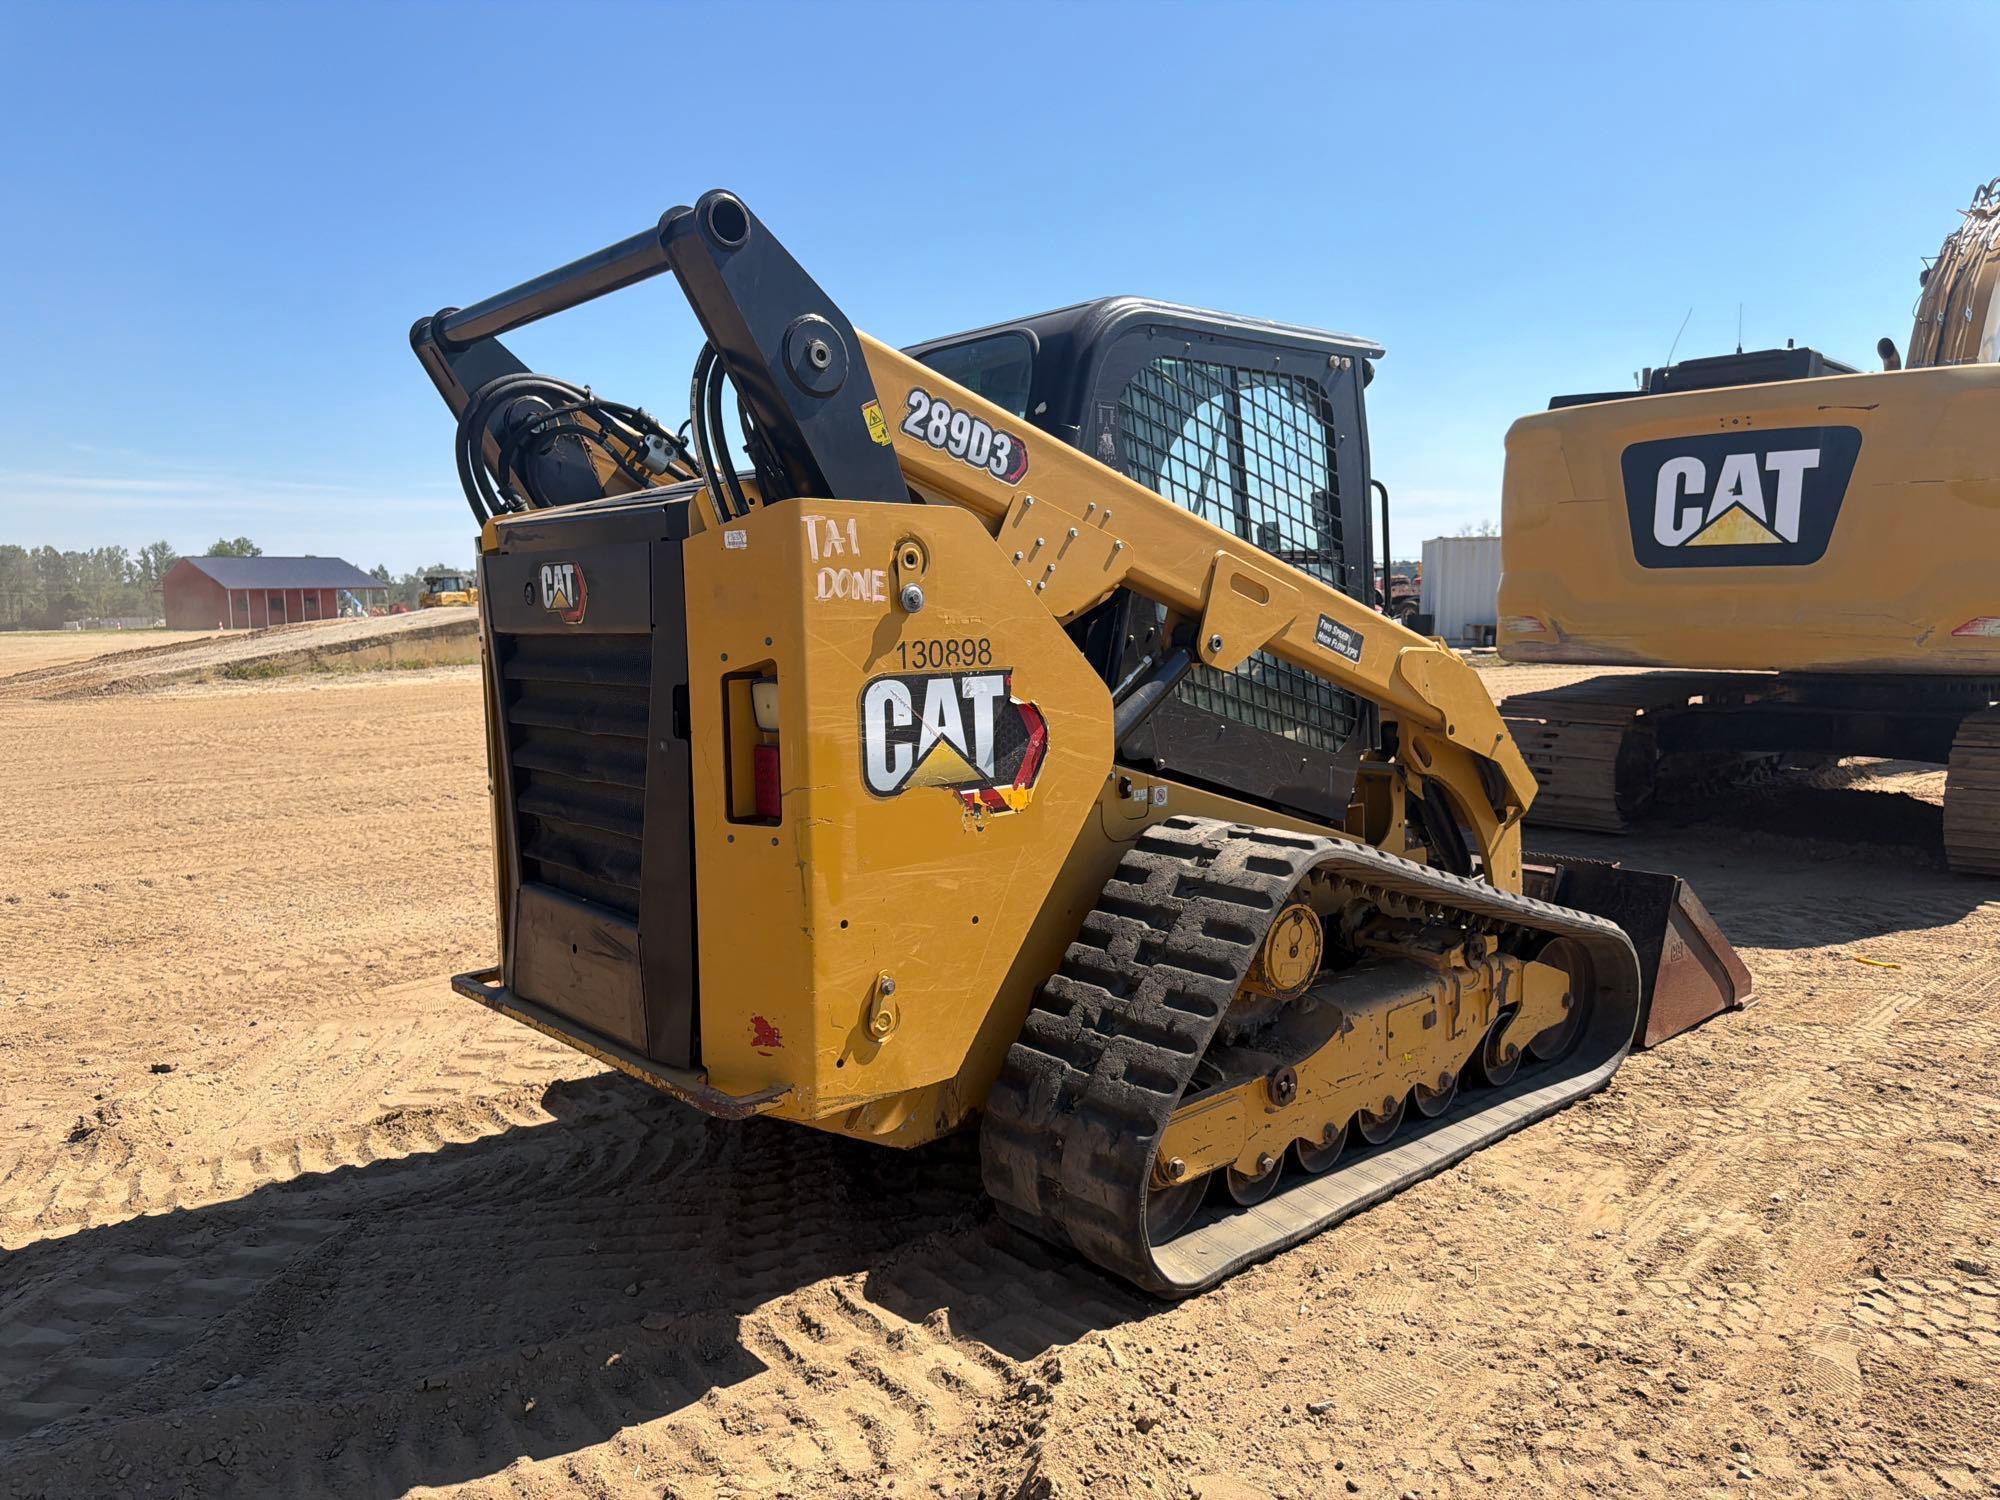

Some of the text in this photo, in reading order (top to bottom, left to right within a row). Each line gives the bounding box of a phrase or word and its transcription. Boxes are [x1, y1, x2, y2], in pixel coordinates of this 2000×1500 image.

[903, 390, 1012, 476] 289D3
[1653, 448, 1820, 547] CAT
[540, 564, 574, 609] CAT
[815, 567, 888, 602] DONE
[896, 638, 992, 669] 130898
[864, 674, 1004, 791] CAT
